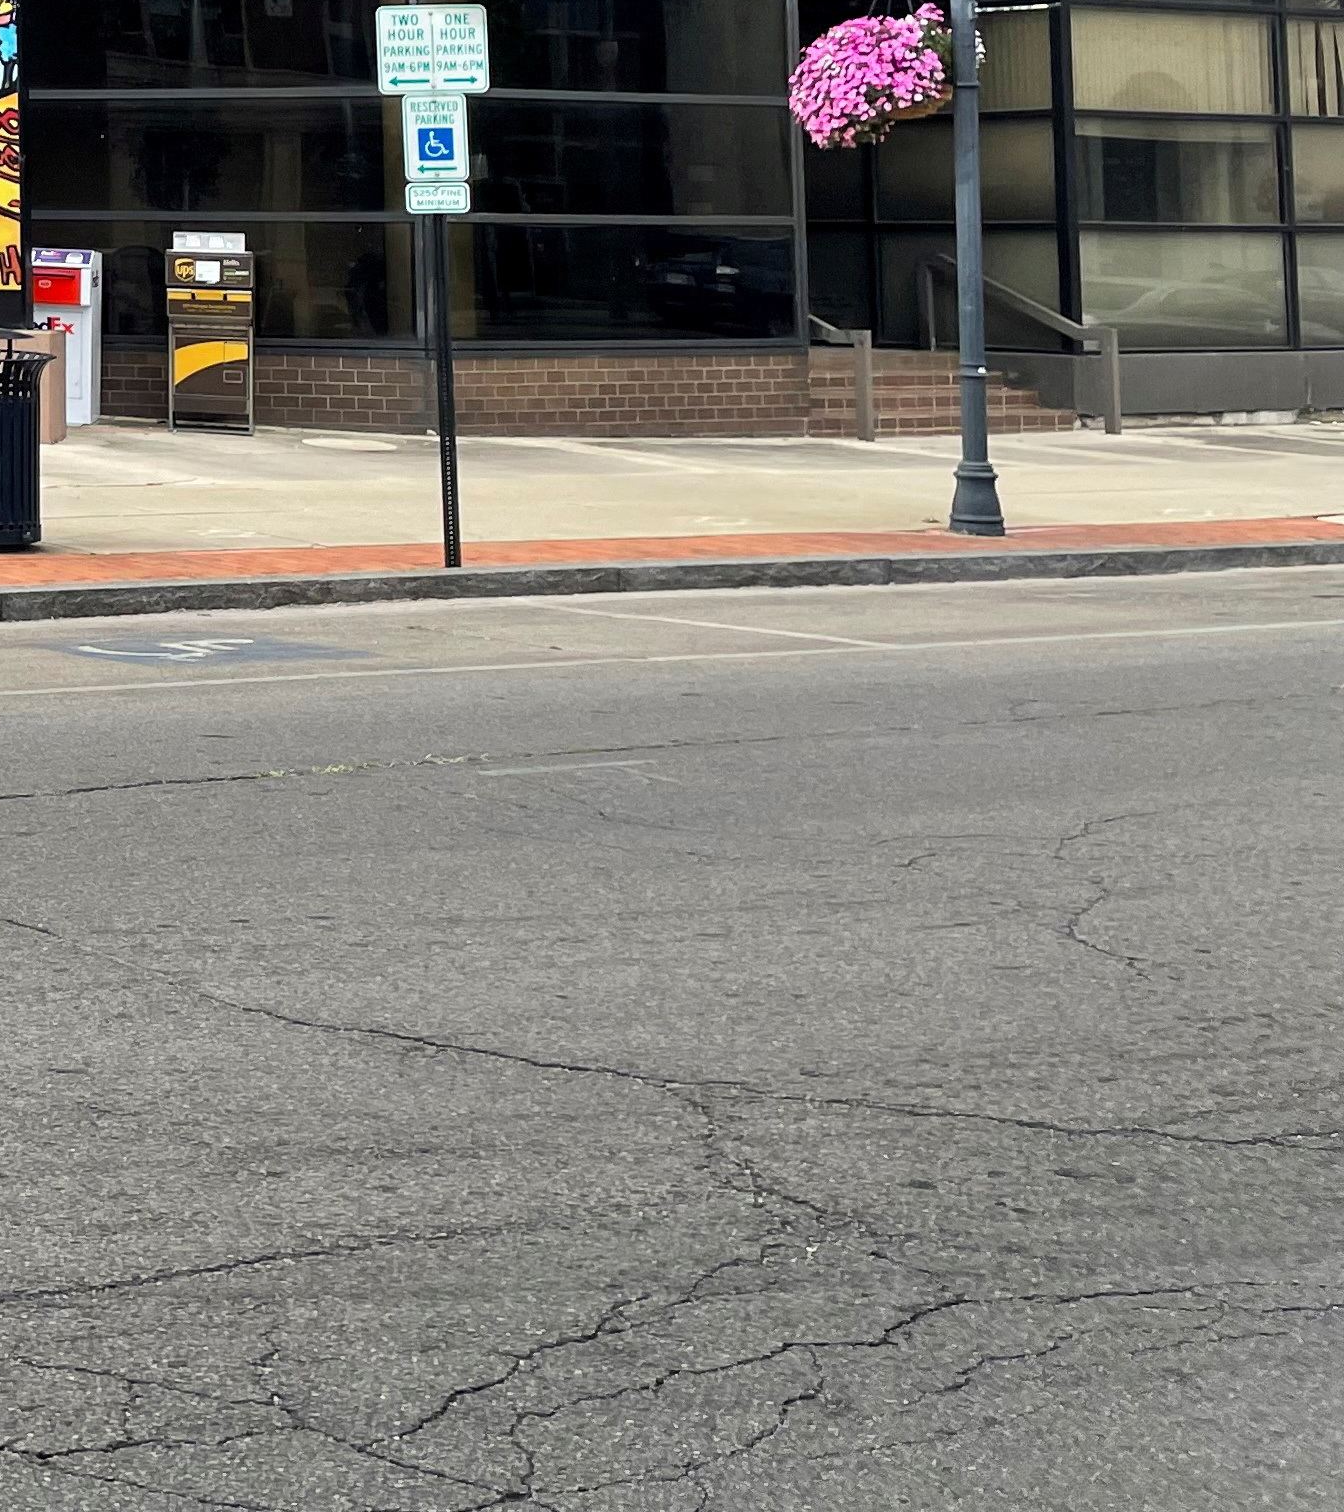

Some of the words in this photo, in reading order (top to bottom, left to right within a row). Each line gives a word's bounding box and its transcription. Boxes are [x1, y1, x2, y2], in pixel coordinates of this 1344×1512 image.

[391, 14, 419, 26] TWO
[444, 13, 470, 25] ONE
[387, 28, 425, 41] HOUR
[440, 27, 476, 40] HOUR
[383, 45, 430, 57] PARKING
[436, 43, 483, 55] PARKING
[384, 61, 430, 74] 9AM-6PM
[436, 59, 484, 72] 9AM-6PM
[410, 101, 459, 113] RESERVED
[415, 113, 455, 126] PARKING
[440, 188, 463, 197] FINE
[416, 198, 460, 207] MINIMUM
